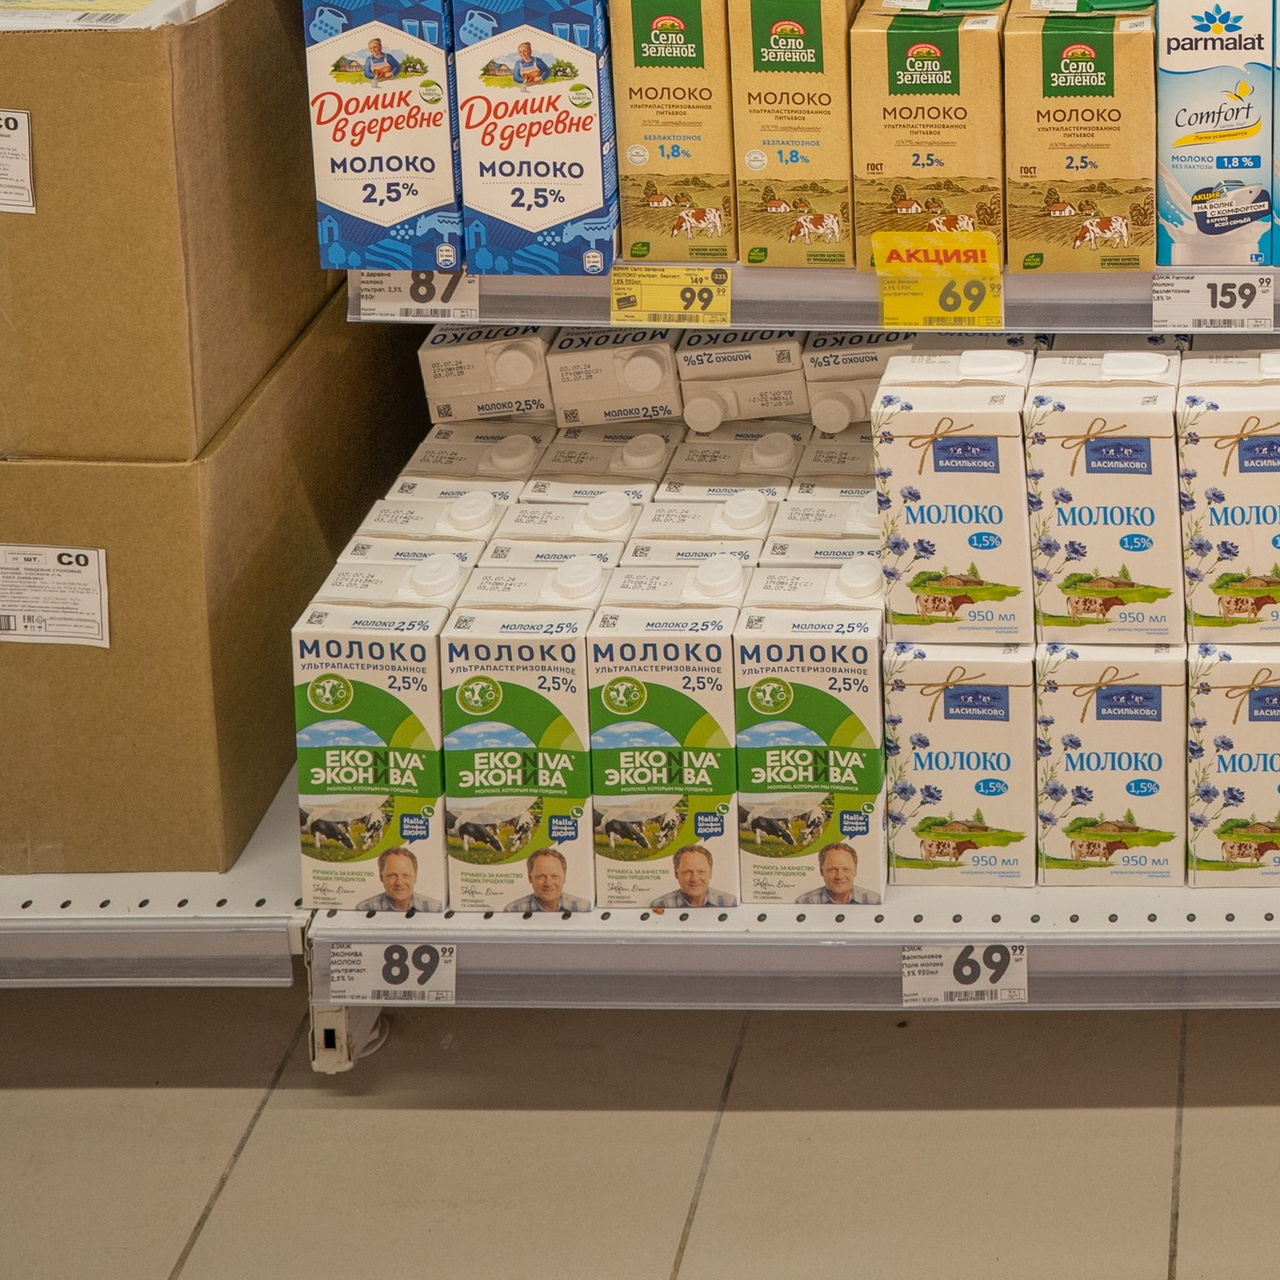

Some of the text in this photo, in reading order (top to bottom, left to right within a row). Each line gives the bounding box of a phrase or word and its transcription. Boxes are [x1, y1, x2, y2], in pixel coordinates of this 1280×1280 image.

[1166, 34, 1264, 56] parmalat
[311, 90, 411, 126] Домик
[1175, 103, 1254, 129] Comfort
[333, 108, 444, 147] в деревне
[658, 144, 691, 159] 1,8%
[362, 181, 419, 206] 2,5%
[1192, 190, 1220, 203] АКЦИЯ
[1207, 282, 1256, 309] 159
[939, 460, 994, 468] ВАСИЛЬКОВО
[905, 505, 1003, 525] МОЛОКО
[971, 534, 1001, 548] 1,5%
[968, 611, 1016, 623] 950 мл
[299, 640, 427, 663] МОЛОКО
[302, 662, 427, 674] УЛЬТРАПАСТЕРИЗОВАННОЕ
[382, 945, 439, 984] 89
[953, 945, 1004, 985] 69
